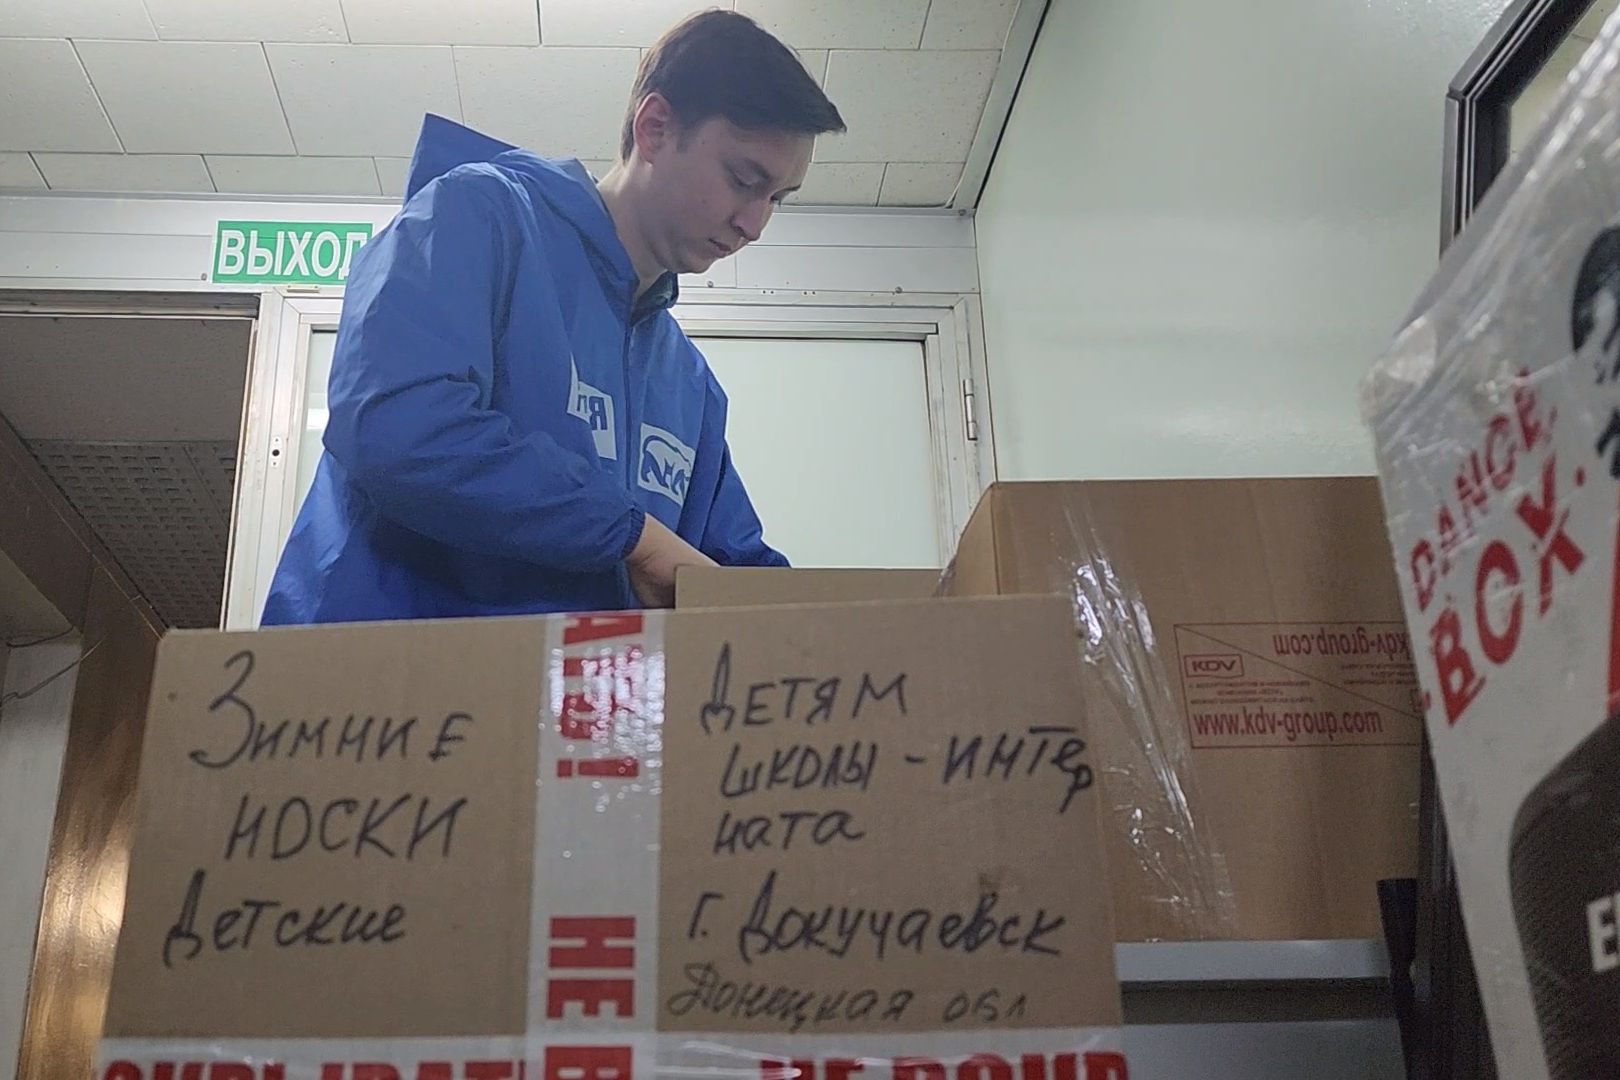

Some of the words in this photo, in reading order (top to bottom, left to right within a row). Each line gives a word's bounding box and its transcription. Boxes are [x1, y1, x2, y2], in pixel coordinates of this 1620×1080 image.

[218, 229, 368, 280] ВЫХОД
[1191, 659, 1237, 672] KDV
[1193, 705, 1384, 741] www.kdv-group.com
[162, 868, 408, 970] Детские
[738, 869, 1067, 965] Докучаевск
[547, 916, 637, 1019] НЕ
